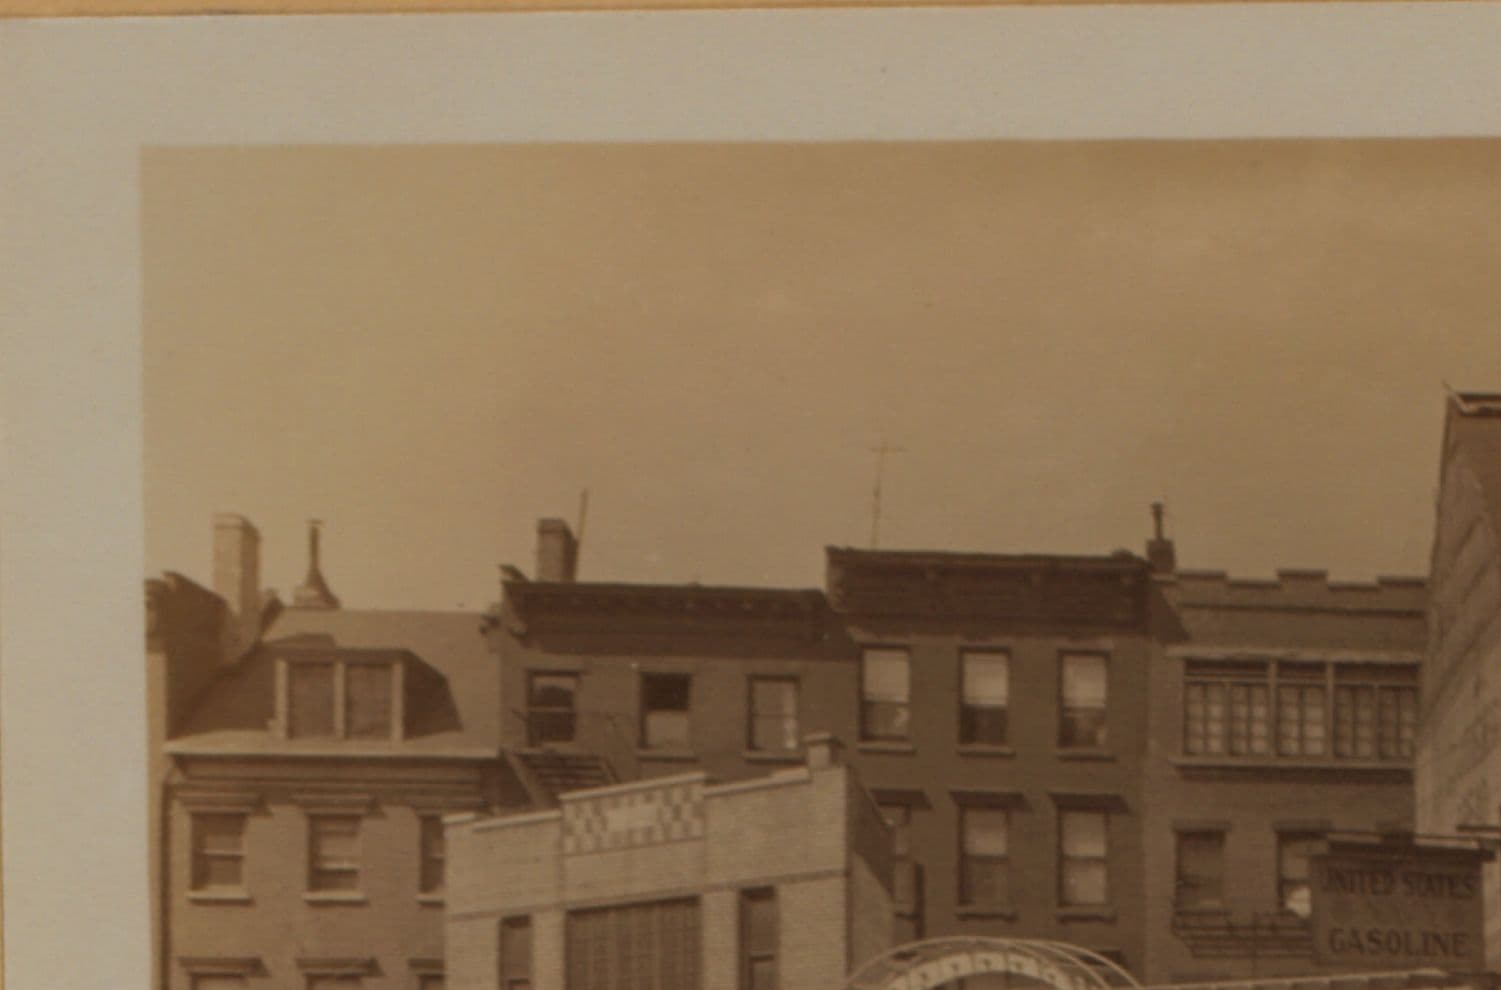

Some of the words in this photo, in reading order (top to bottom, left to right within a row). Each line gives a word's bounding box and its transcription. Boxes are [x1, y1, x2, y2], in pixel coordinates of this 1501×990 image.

[1321, 869, 1395, 895] UNITED
[1400, 871, 1475, 897] STATES
[1329, 927, 1472, 958] GASOLINE
